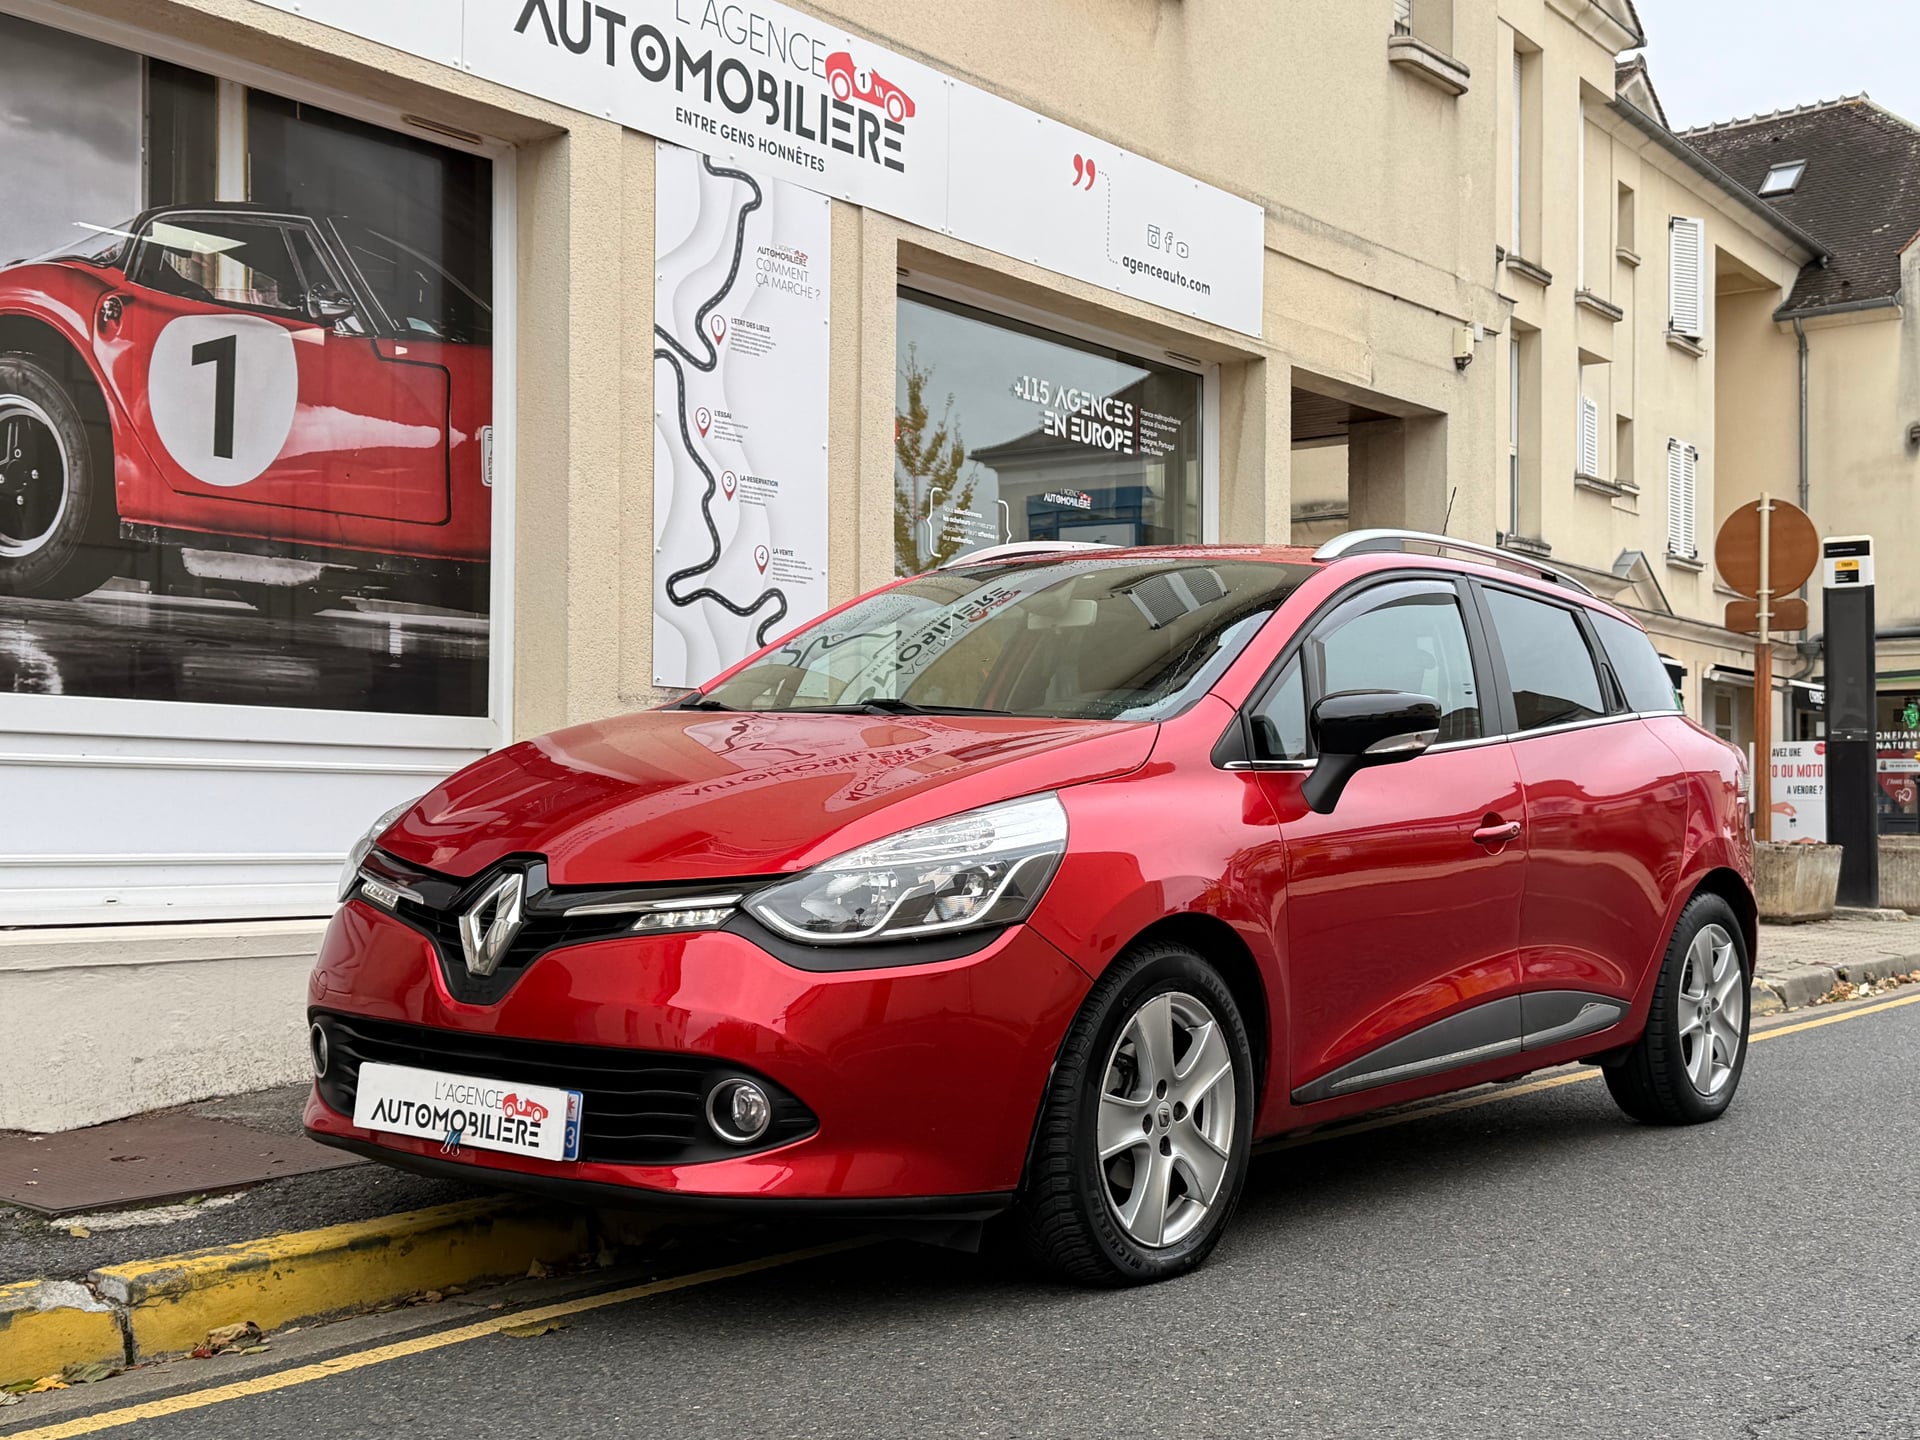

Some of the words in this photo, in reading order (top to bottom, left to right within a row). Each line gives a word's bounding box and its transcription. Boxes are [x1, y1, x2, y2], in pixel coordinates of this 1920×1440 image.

[676, 0, 826, 79] LAGENCE
[676, 107, 717, 135] ENTRE
[720, 124, 755, 148] GENS
[758, 137, 825, 172] HONNÊTES
[756, 257, 809, 282] COMMENT
[1122, 255, 1211, 295] agenceauto.com
[755, 272, 770, 288] ÇA
[771, 277, 813, 299] MARCHE
[815, 288, 821, 300] ?
[192, 334, 236, 460] 1
[1014, 375, 1049, 405] +115
[1055, 385, 1133, 427] AGENCES
[700, 412, 707, 423] 2
[1044, 410, 1067, 438] EN
[1071, 416, 1133, 454] EUROPE
[726, 476, 732, 487] 3
[759, 550, 764, 560] 4
[779, 549, 794, 557] VENTE
[1772, 748, 1788, 757] AVEZ
[1788, 747, 1802, 757] UNE
[1781, 764, 1793, 778] OU
[1797, 763, 1824, 778] MOTO
[1793, 785, 1818, 795] VENDRE
[434, 1081, 505, 1110] L'AGENCE
[371, 1097, 541, 1148] AUTOMOBILIERE
